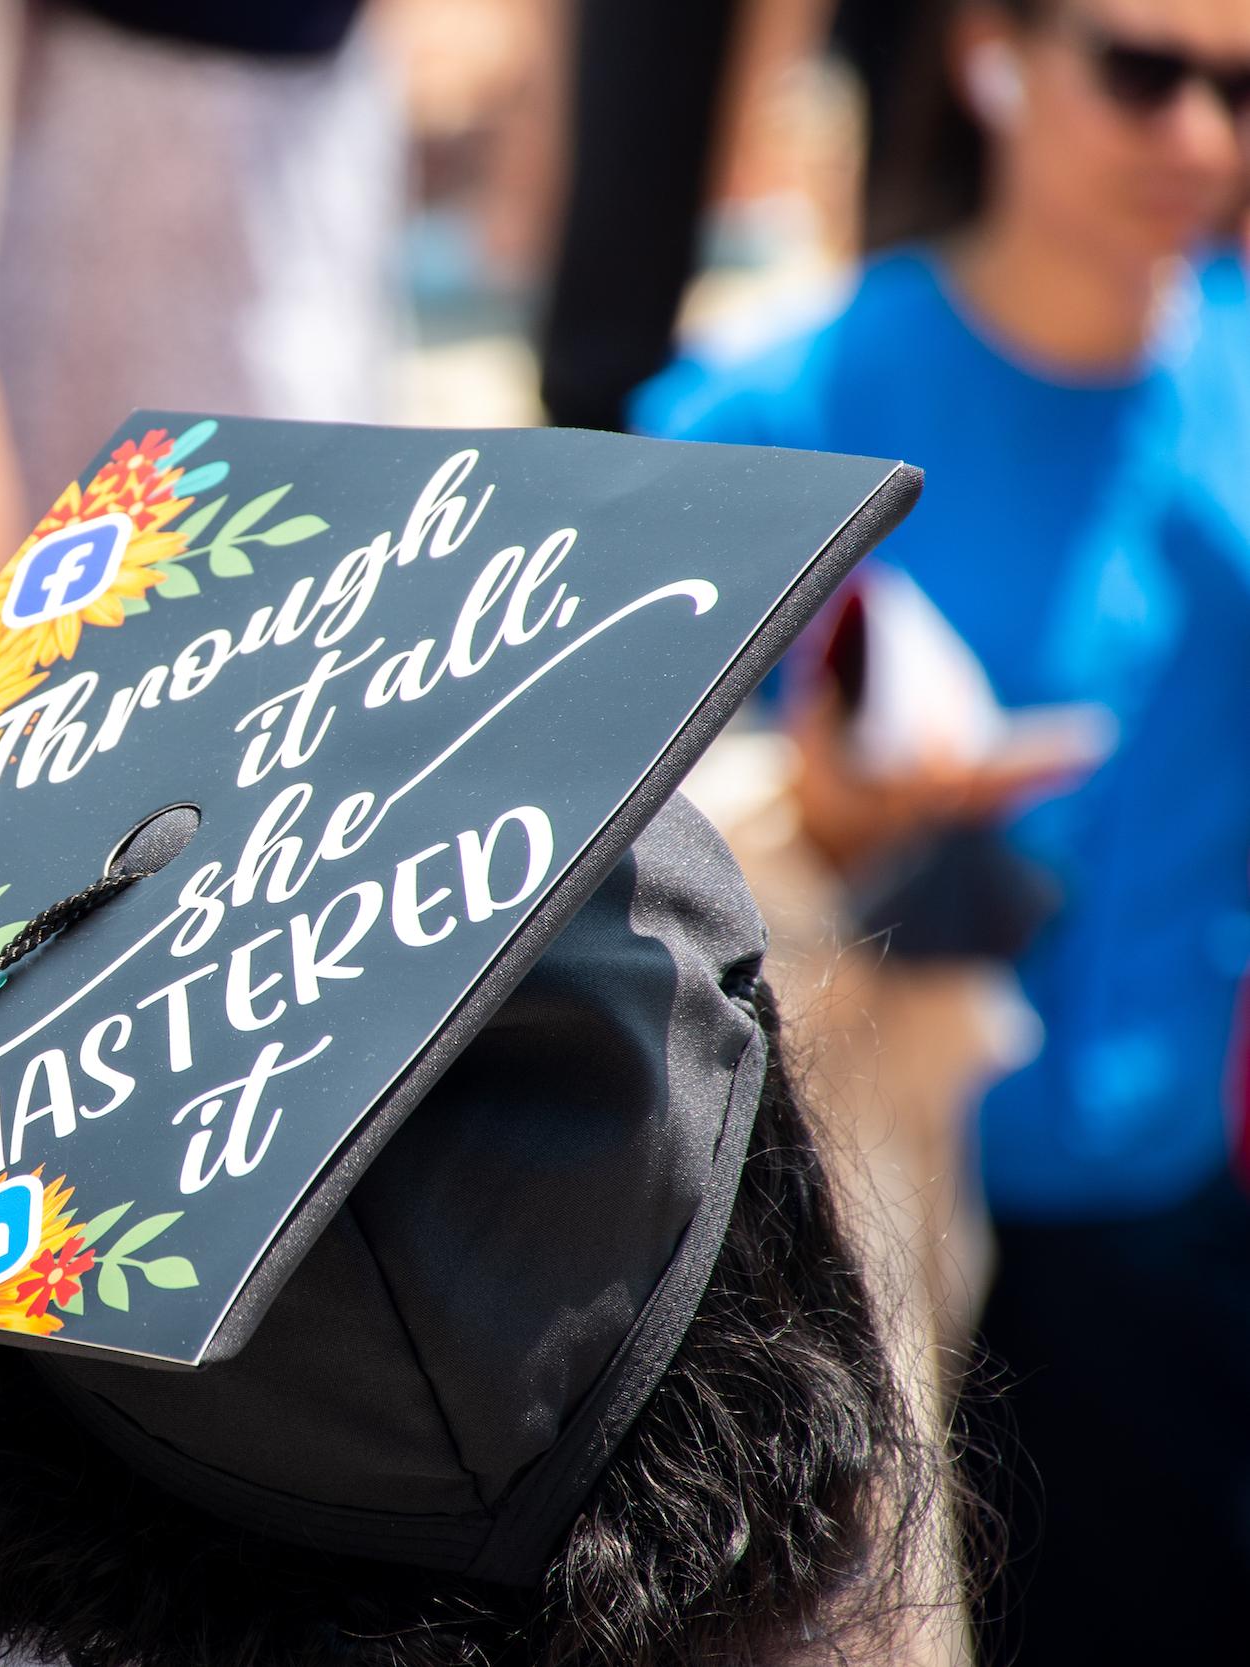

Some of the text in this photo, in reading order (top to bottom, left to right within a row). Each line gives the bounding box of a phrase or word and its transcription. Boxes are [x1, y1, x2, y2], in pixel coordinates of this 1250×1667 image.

[39, 539, 88, 613] f
[234, 527, 581, 789] it all,
[171, 1034, 333, 1195] it
